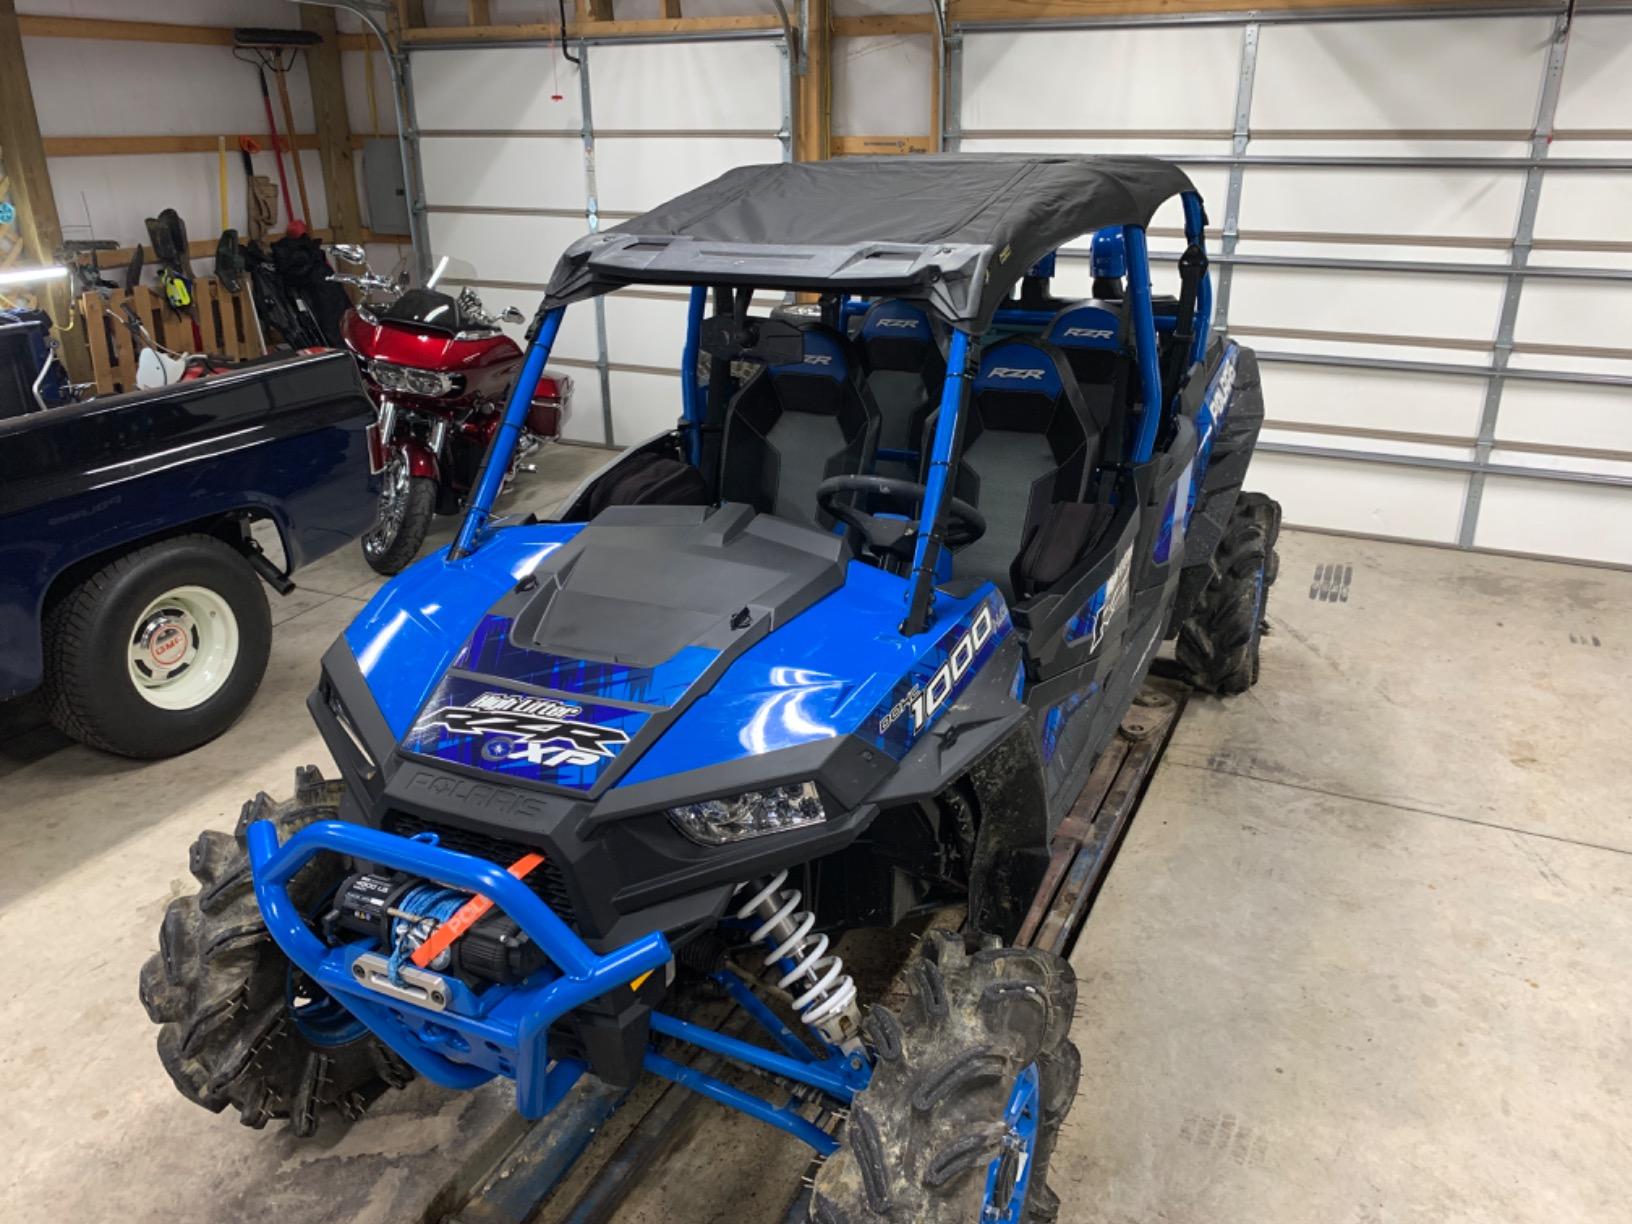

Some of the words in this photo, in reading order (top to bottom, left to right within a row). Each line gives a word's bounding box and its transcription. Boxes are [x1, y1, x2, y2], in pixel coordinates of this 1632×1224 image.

[876, 319, 919, 328] RZR
[1063, 327, 1114, 339] RZR
[803, 354, 832, 365] ZR
[987, 367, 1046, 380] RZR
[155, 637, 181, 655] GMC
[911, 604, 993, 735] 1000
[412, 706, 632, 758] RZR
[507, 742, 600, 766] XP
[406, 772, 547, 817] POLARIS
